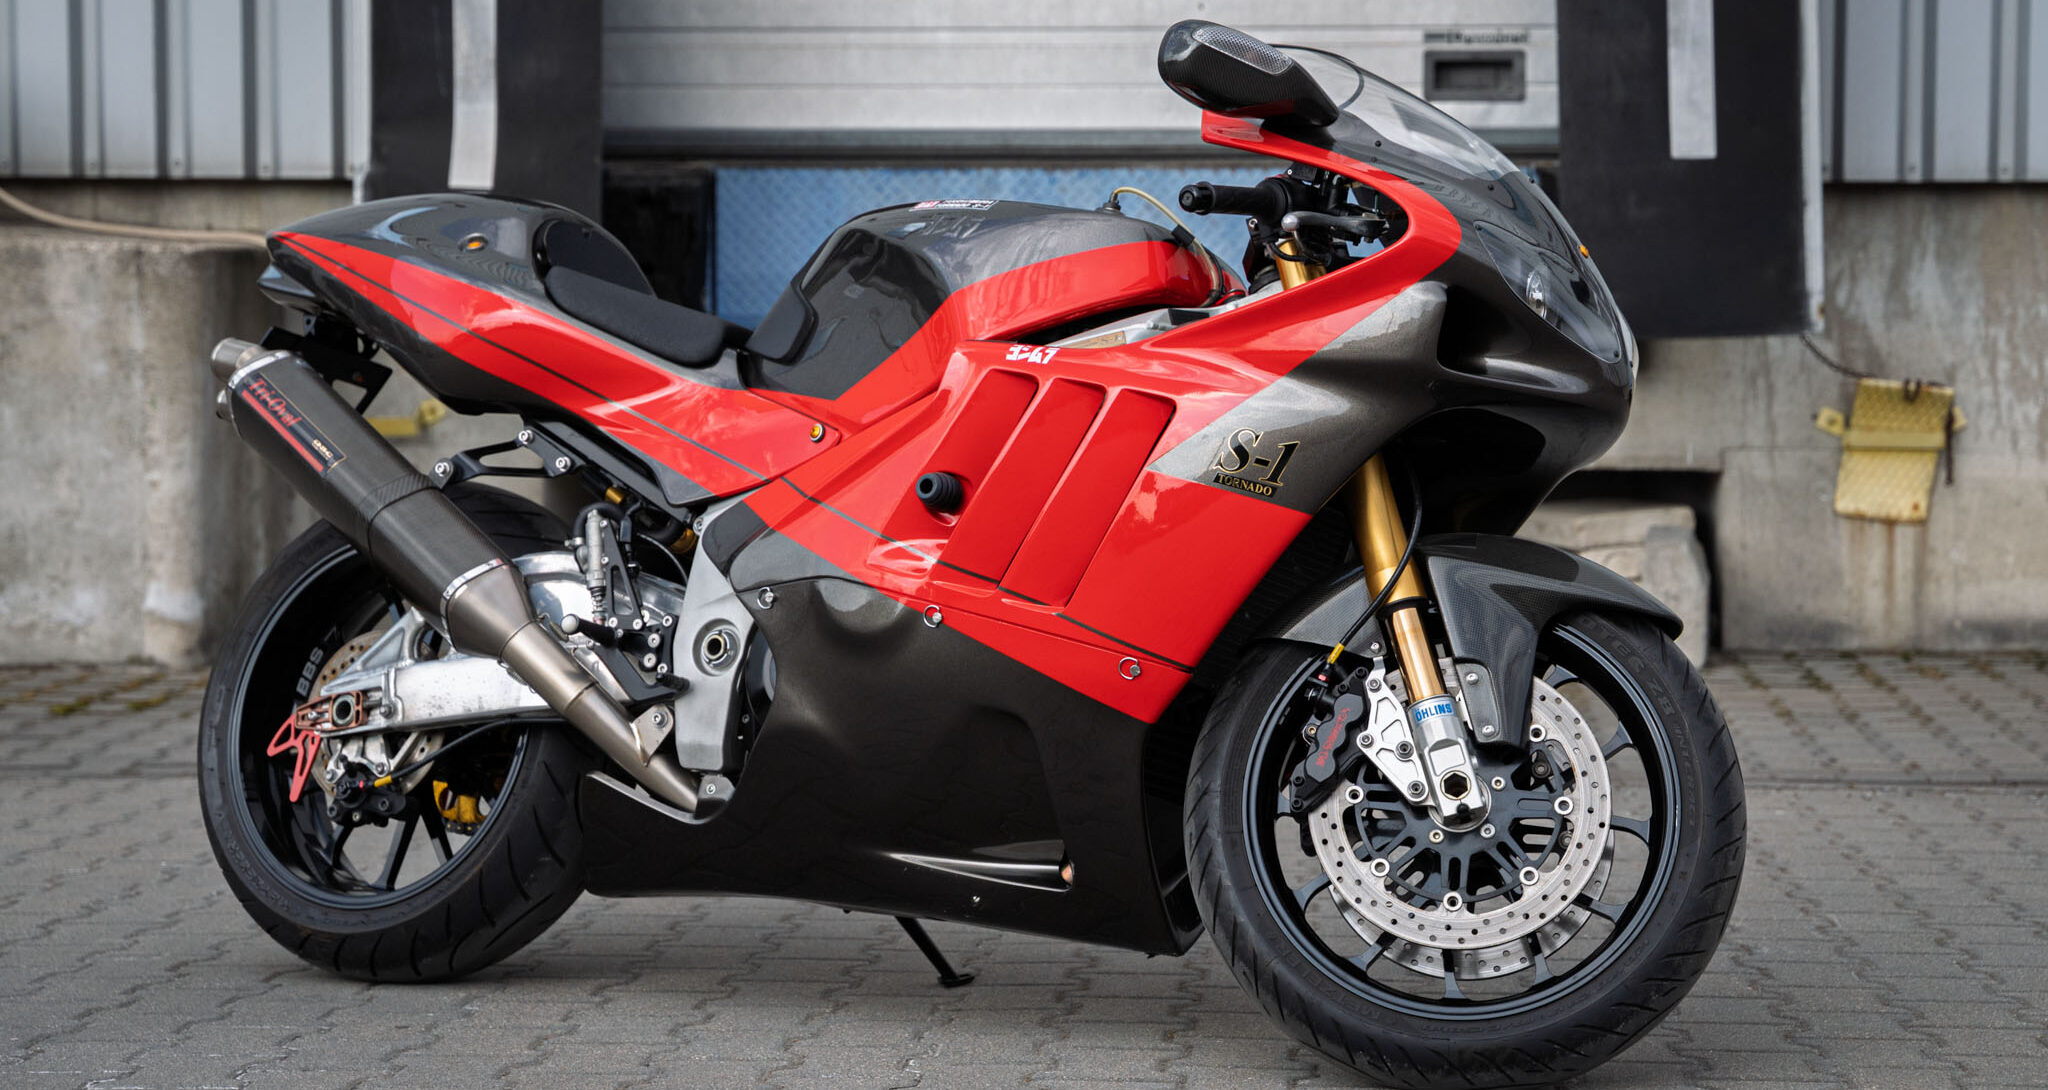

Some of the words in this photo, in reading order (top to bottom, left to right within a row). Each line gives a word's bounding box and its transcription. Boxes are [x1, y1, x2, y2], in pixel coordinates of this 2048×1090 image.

[249, 378, 302, 428] Tri-Oval
[1210, 427, 1300, 486] S-1
[1217, 474, 1272, 496] TORNADO
[296, 647, 323, 697] BBS
[1415, 702, 1453, 721] ÖHLINS
